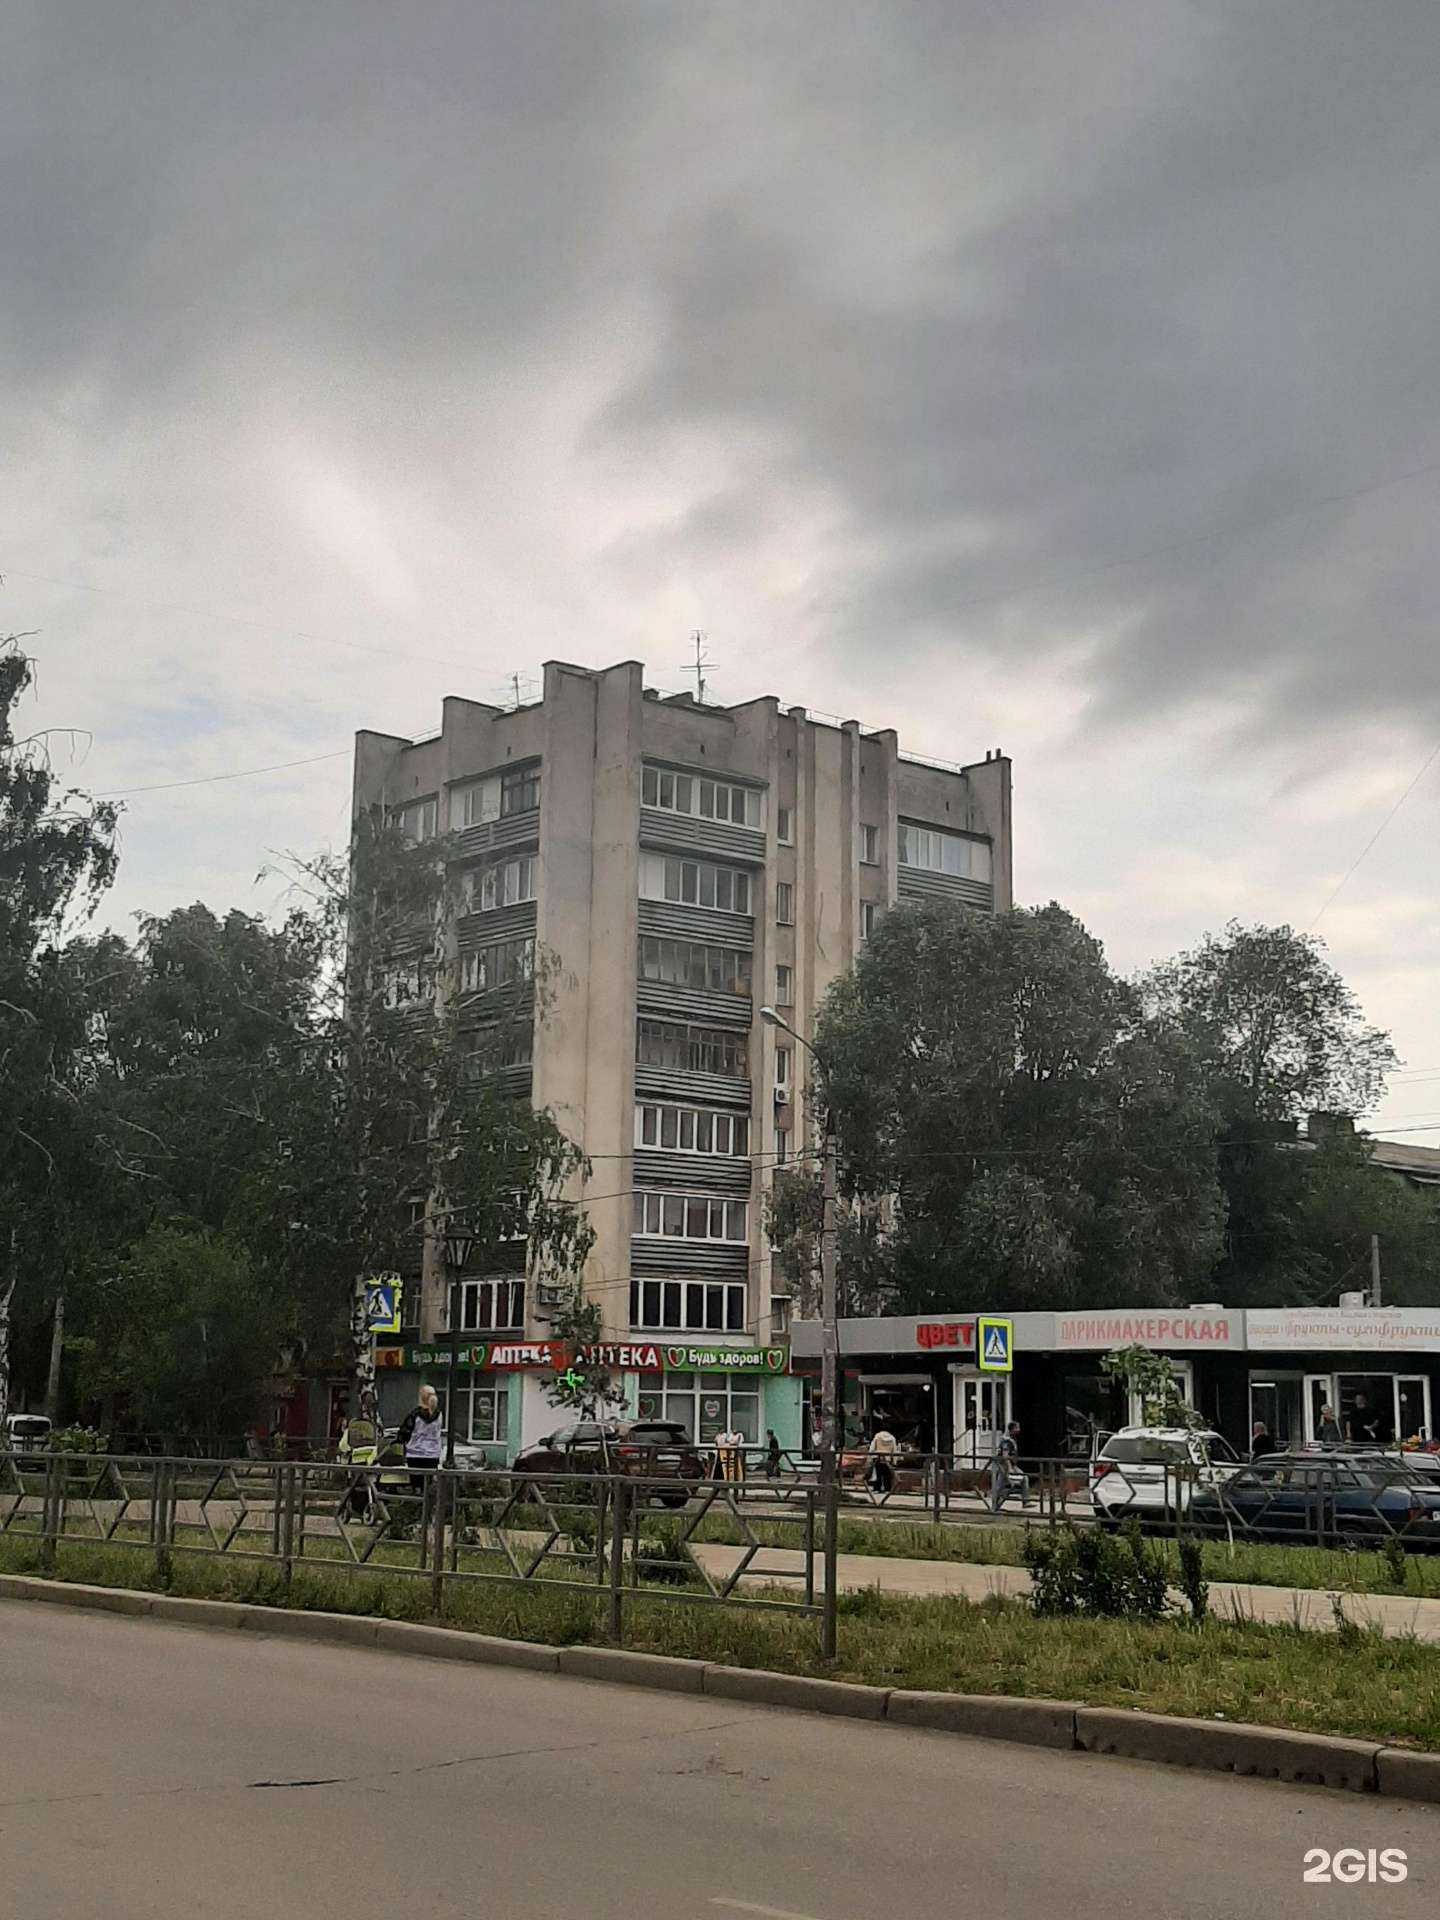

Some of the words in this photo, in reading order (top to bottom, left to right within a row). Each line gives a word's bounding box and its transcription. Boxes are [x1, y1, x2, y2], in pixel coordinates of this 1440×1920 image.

[916, 1322, 975, 1348] ЦВЕТ
[1061, 1319, 1229, 1344] ПАРИКМАХЕРСКАЯ
[688, 1349, 717, 1367] Будь
[718, 1351, 764, 1367] здоров!
